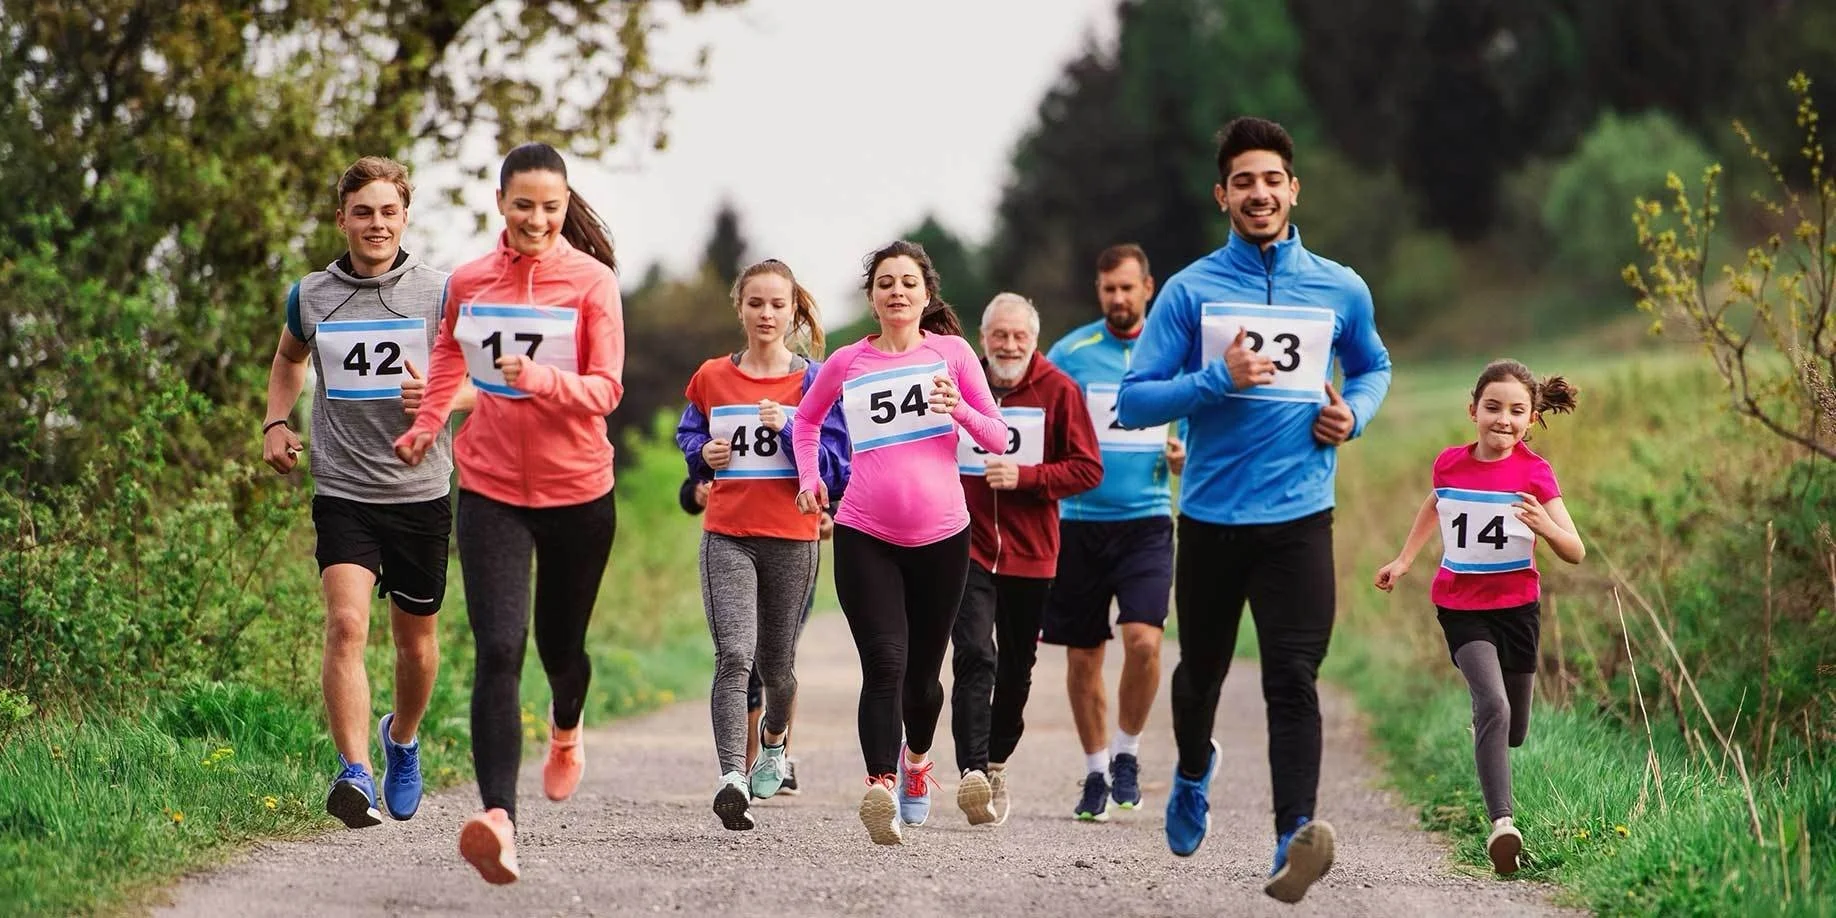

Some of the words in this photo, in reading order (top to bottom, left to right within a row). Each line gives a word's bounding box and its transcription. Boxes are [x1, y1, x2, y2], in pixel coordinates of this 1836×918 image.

[343, 341, 403, 376] 42
[482, 331, 543, 369] 17
[870, 384, 928, 424] 54
[731, 425, 778, 457] 48
[972, 426, 1021, 455] 9
[1451, 513, 1508, 549] 14
